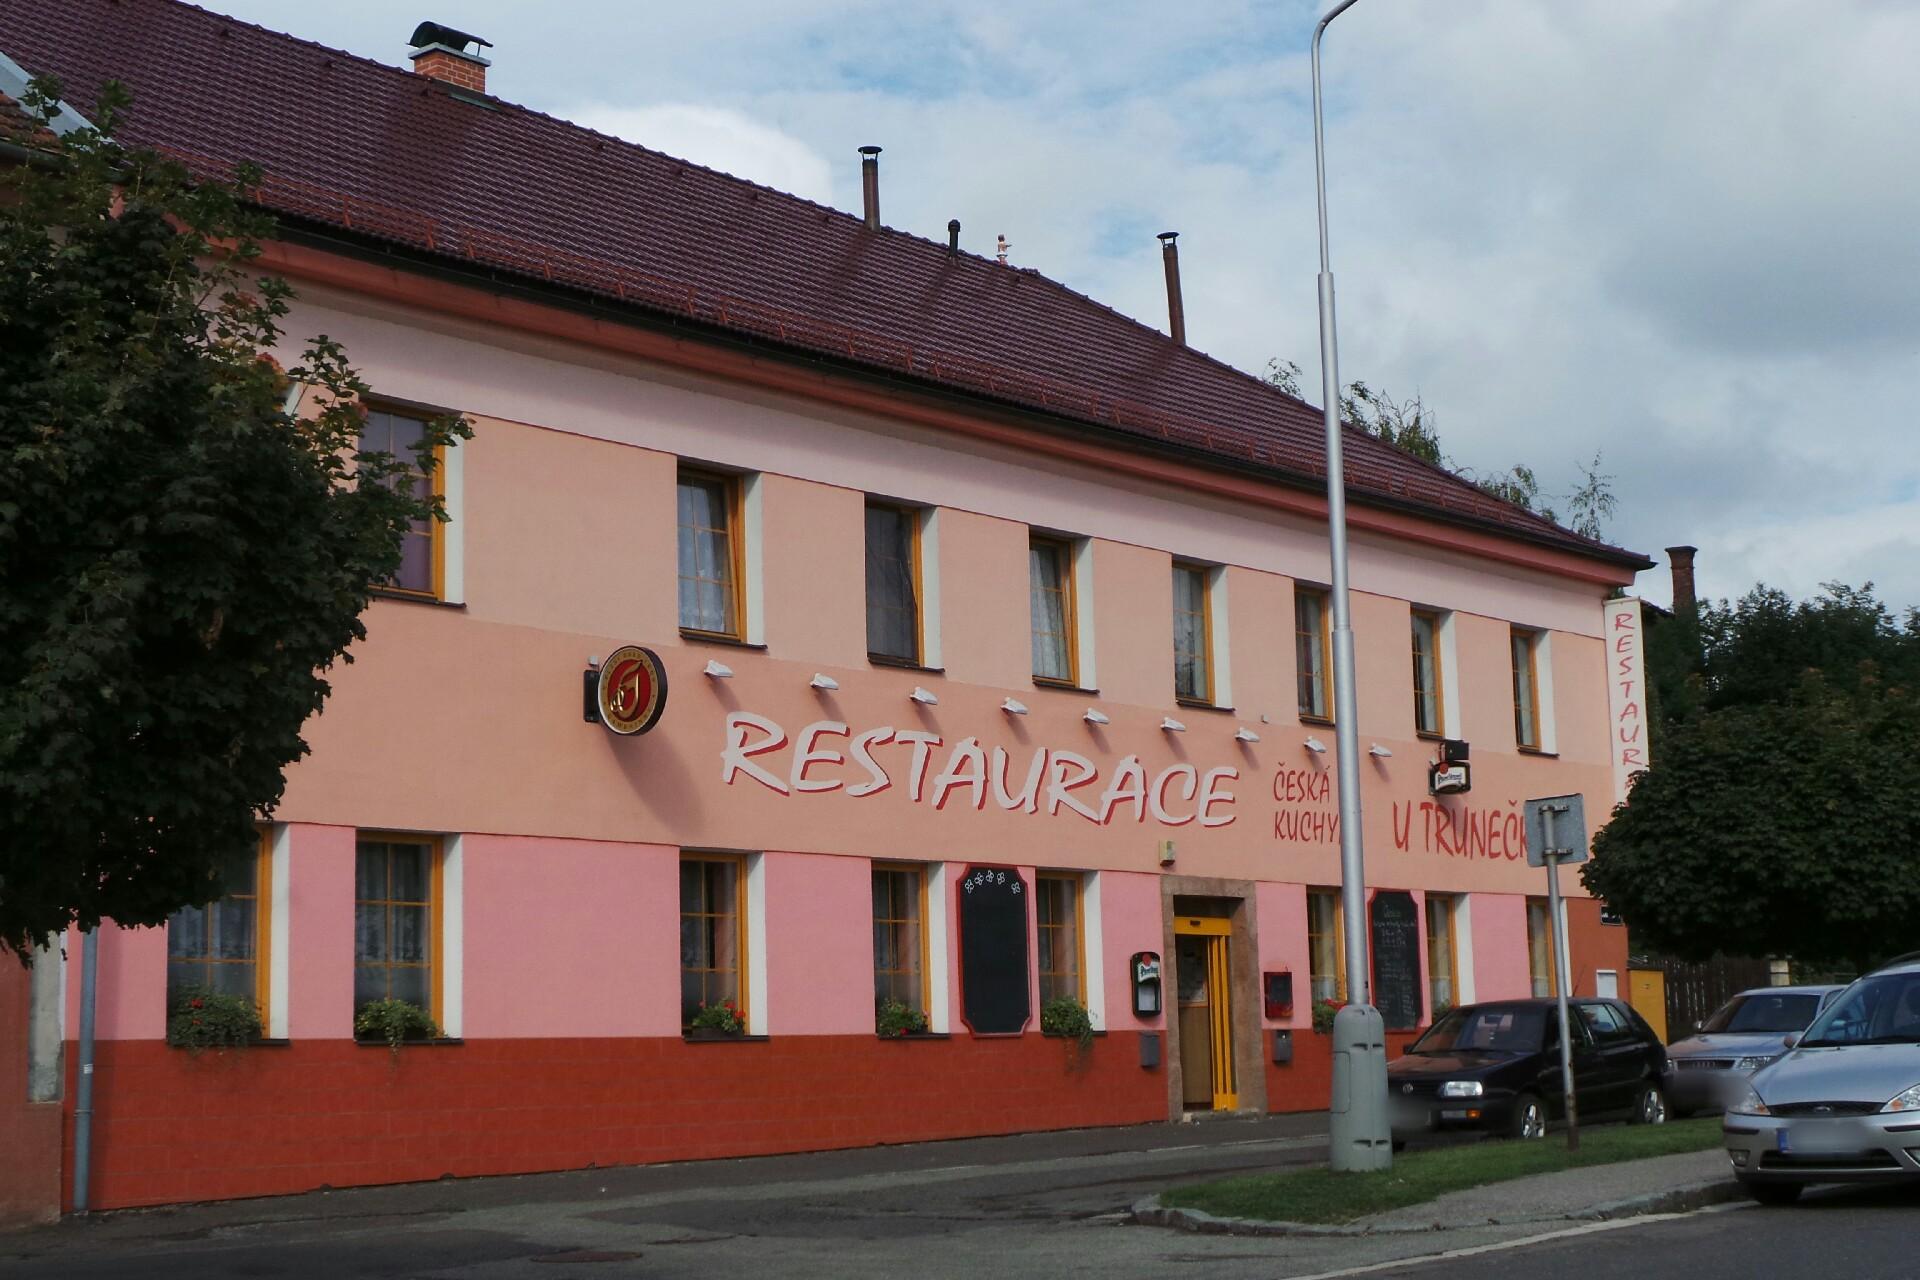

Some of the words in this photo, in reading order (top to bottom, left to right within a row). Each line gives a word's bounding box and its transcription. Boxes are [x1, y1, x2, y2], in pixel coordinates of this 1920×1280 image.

[1614, 613, 1642, 807] RESTAUR
[721, 711, 1240, 828] RESTAURACE
[1273, 762, 1331, 804] ČESKÁ
[1274, 809, 1341, 845] KUCHY
[1392, 800, 1411, 852] U
